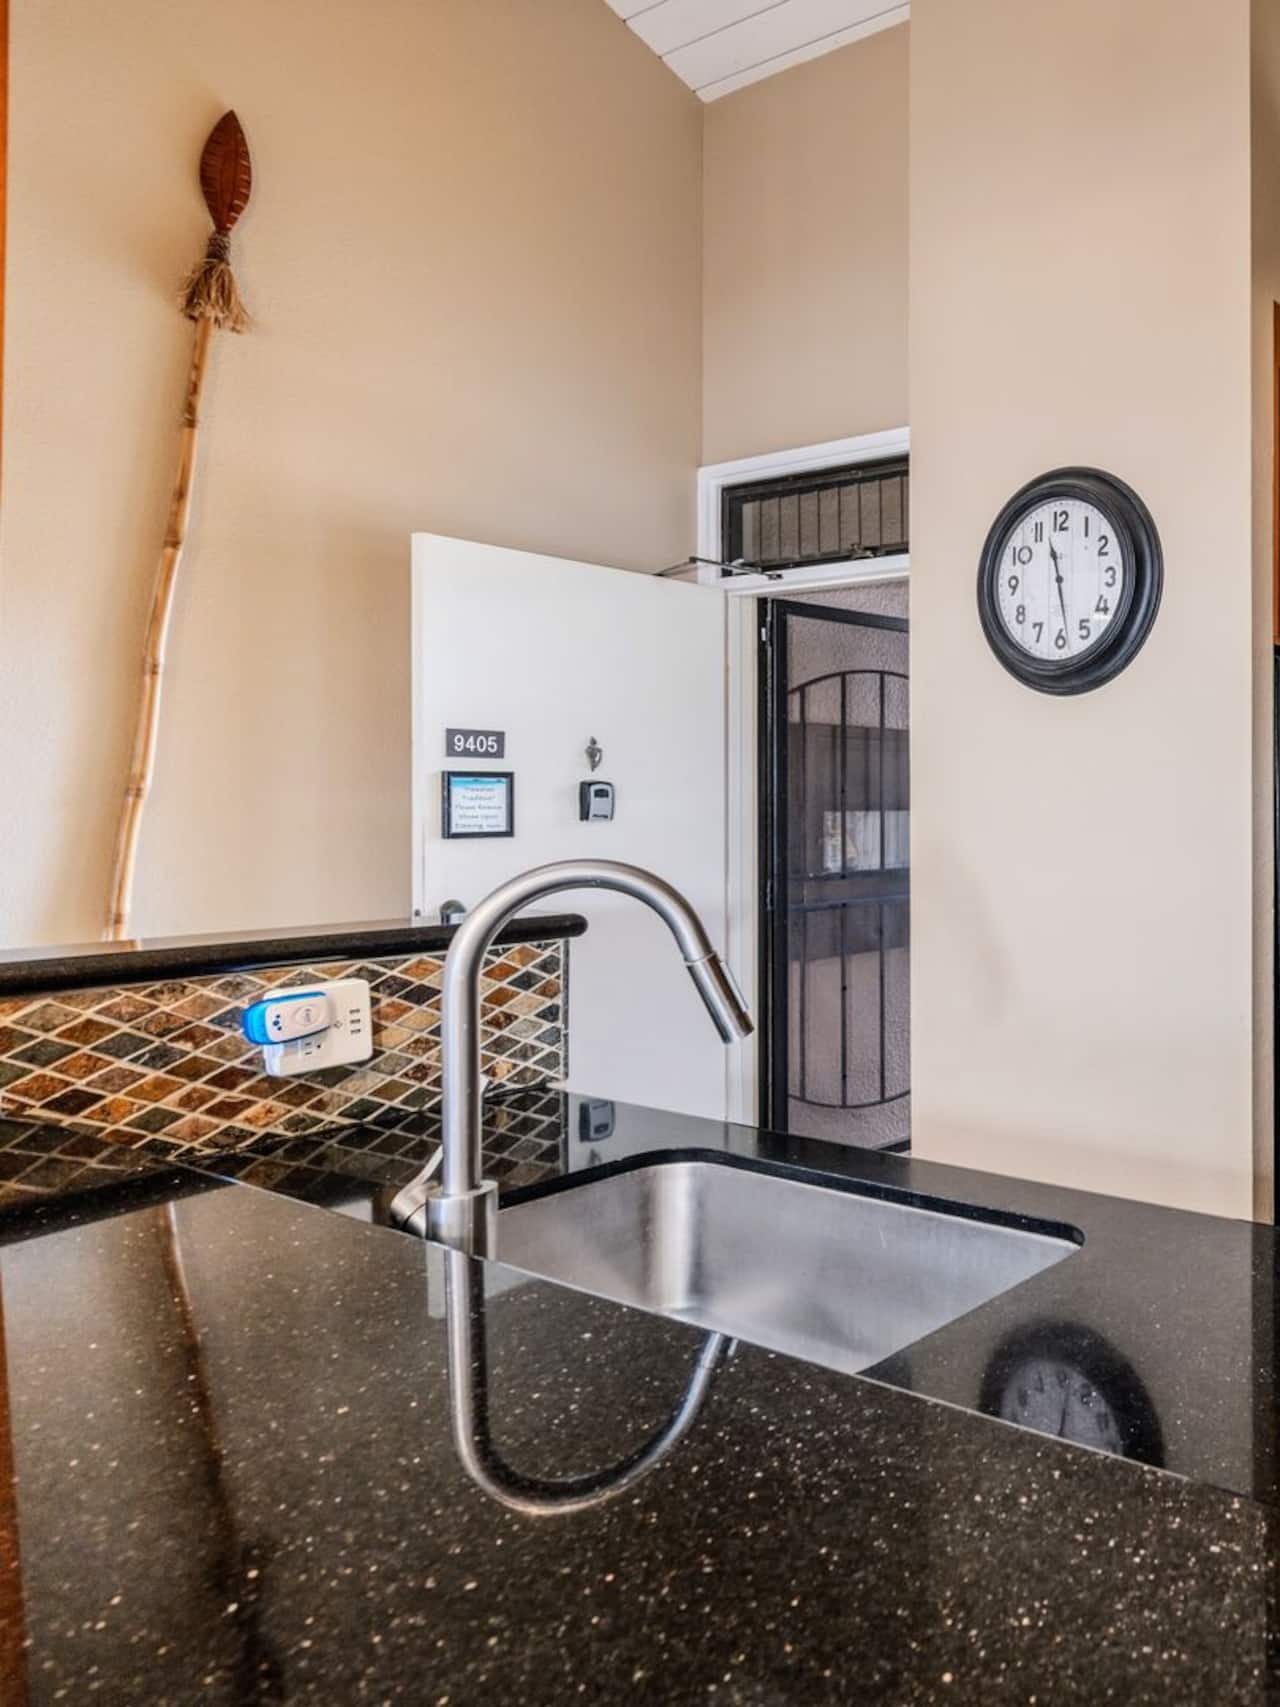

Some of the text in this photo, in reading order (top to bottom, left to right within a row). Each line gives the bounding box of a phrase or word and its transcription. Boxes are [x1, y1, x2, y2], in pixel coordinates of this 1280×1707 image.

[1053, 511, 1070, 532] 12
[1084, 517, 1090, 537] 1
[1034, 522, 1043, 543] 11
[1012, 545, 1033, 566] 10
[1097, 535, 1109, 557] 2
[1008, 575, 1020, 596] 9
[1104, 566, 1117, 587] 3
[1015, 605, 1026, 624] 8
[1095, 595, 1110, 616] 4
[1032, 622, 1044, 644] 7
[1054, 628, 1067, 650] 6
[1078, 618, 1091, 640] 5
[454, 734, 498, 752] 9405
